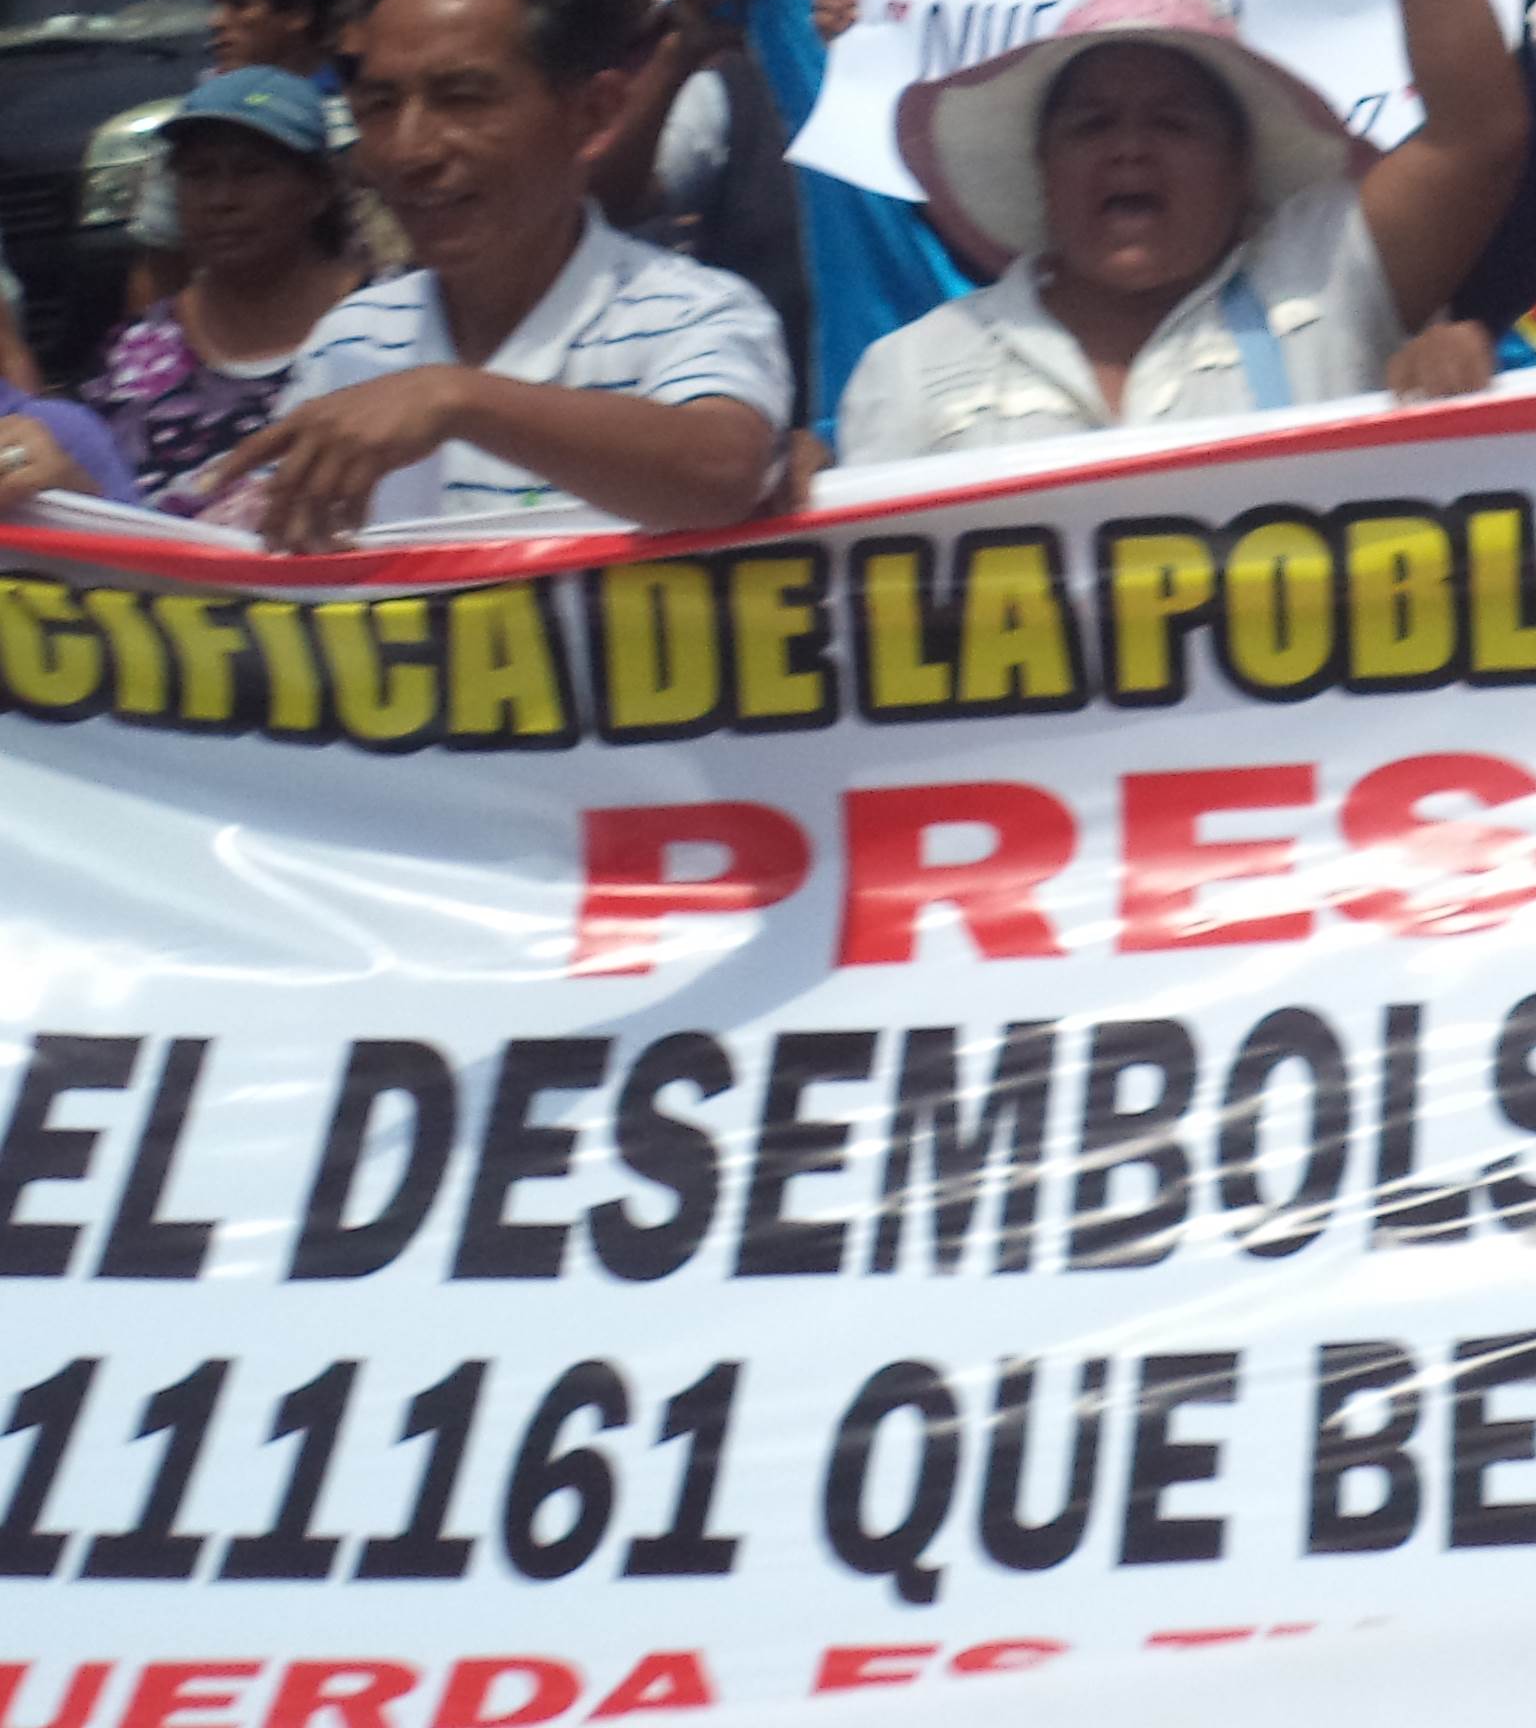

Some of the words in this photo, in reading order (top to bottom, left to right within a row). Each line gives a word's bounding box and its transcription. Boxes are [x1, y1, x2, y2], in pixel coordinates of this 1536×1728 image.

[588, 544, 837, 748] DE
[851, 526, 1092, 725] LA
[0, 1033, 218, 1279] EL
[820, 1352, 1241, 1606] QUE
